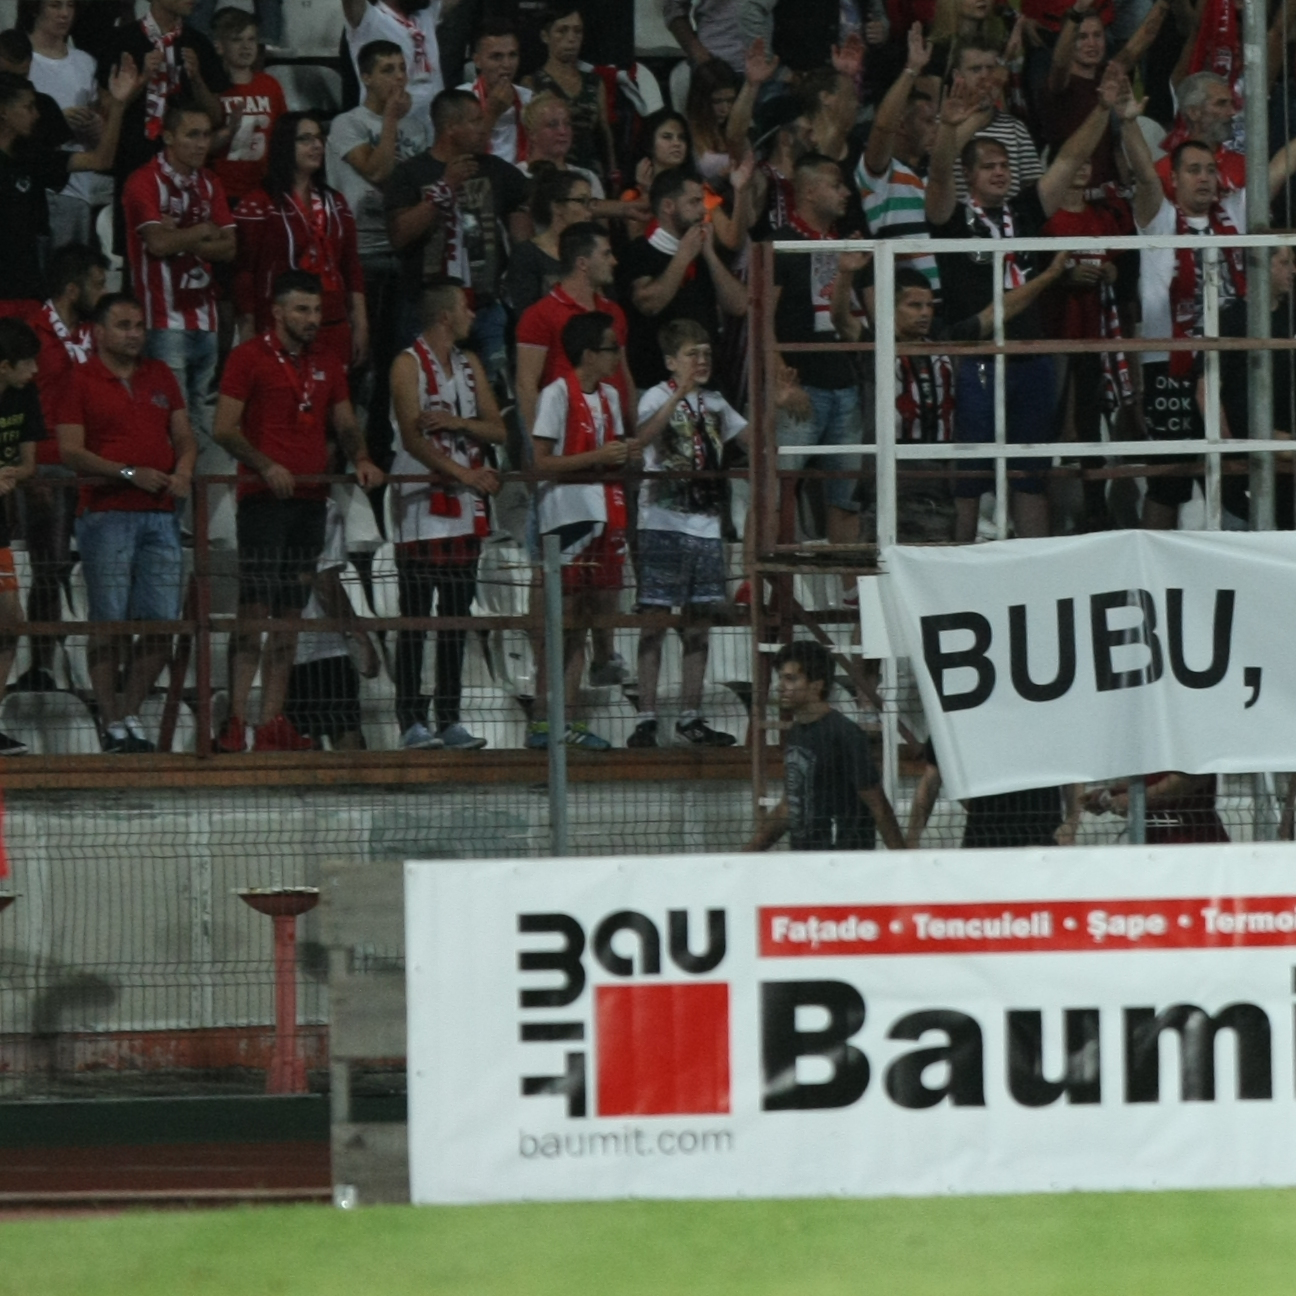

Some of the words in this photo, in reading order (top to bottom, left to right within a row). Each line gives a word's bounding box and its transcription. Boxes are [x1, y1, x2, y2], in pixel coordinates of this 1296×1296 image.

[920, 588, 1263, 709] BUBU,
[914, 911, 1052, 940] Tencuieli
[518, 1124, 735, 1160] baumit.com
